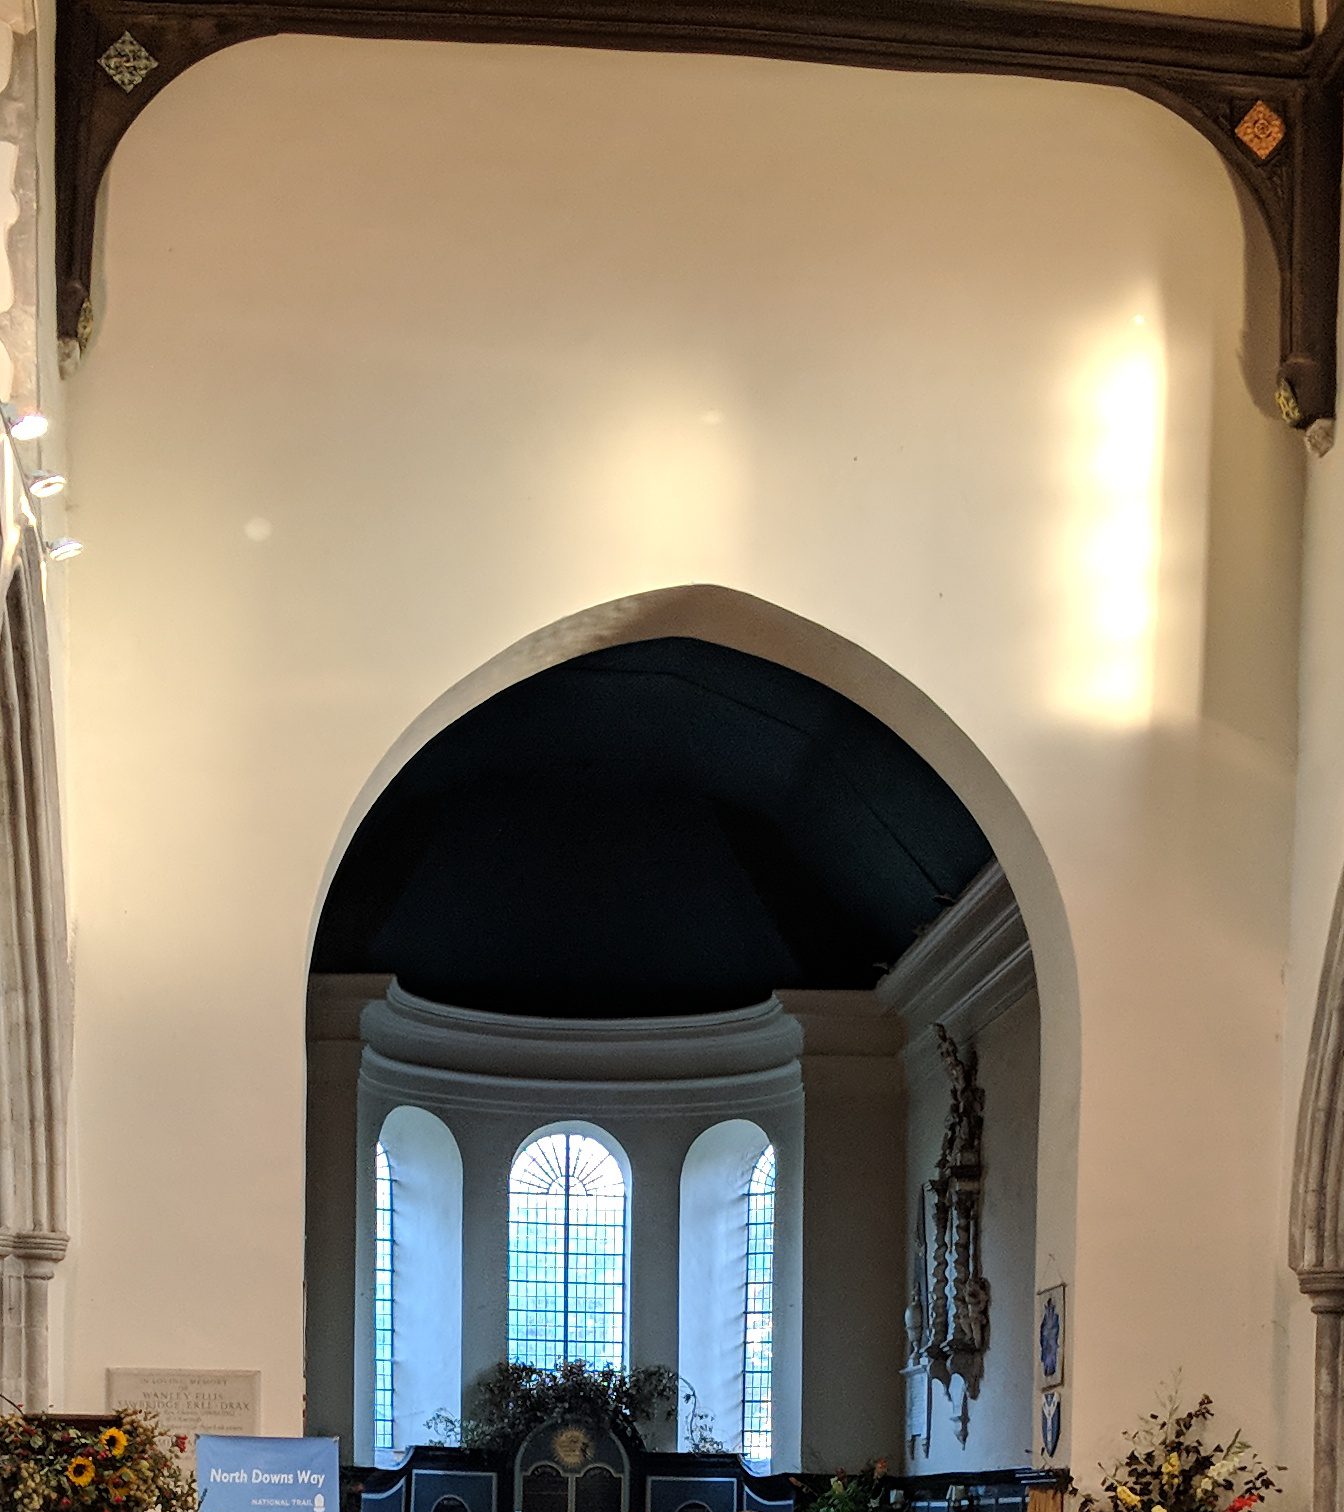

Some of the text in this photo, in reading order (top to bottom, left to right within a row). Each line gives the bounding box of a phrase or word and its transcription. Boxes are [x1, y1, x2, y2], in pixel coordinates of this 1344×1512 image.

[210, 1468, 325, 1488] North Downs Way
